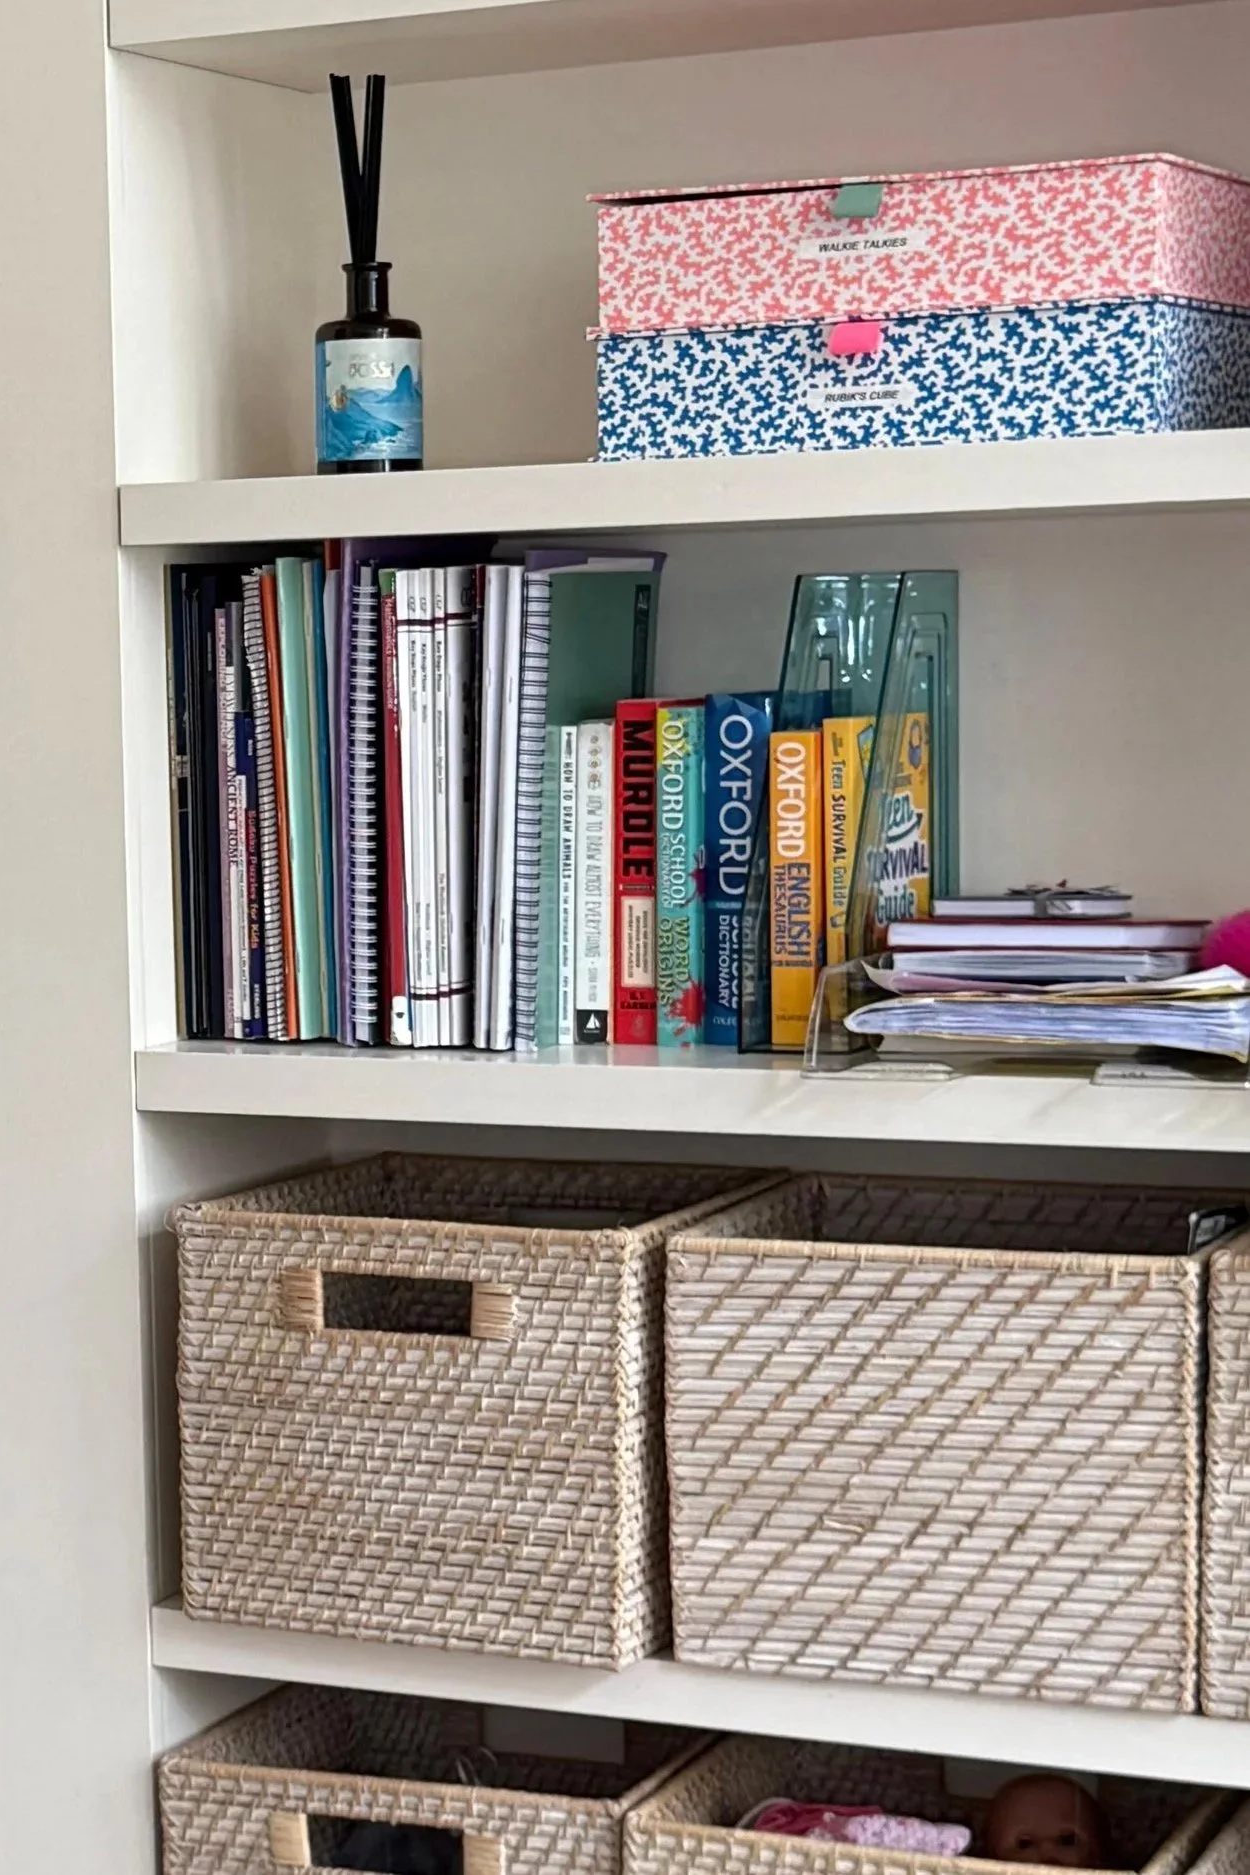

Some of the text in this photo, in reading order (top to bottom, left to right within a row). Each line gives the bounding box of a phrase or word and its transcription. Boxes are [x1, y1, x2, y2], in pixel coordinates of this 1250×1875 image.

[819, 237, 908, 252] WALKIE TALKIES
[824, 390, 900, 402] RUBIK'S CUBE
[227, 766, 238, 823] ANCIENT
[563, 761, 573, 783] HOW
[563, 789, 573, 801] TO
[832, 760, 846, 790] Teen
[563, 806, 573, 832] DRAW
[622, 720, 654, 878] MURDLE
[662, 720, 687, 905] OXFORD SCHOOL
[719, 714, 753, 896] OXFORD
[776, 741, 806, 858] OXFORD
[228, 828, 239, 868] ROME
[586, 821, 602, 832] TO
[586, 836, 603, 860] DRAW
[832, 794, 846, 863] SURVIVAL
[562, 838, 572, 879] ANIMALS
[586, 864, 602, 897] ALMOST
[584, 901, 602, 958] EVERYTHING
[773, 865, 786, 955] THESAURUS
[787, 862, 812, 956] ENGLISH
[251, 923, 259, 949] Kids
[672, 917, 690, 982] WORD
[659, 917, 674, 1007] ORIGINS
[718, 915, 730, 1008] DICTIONARY
